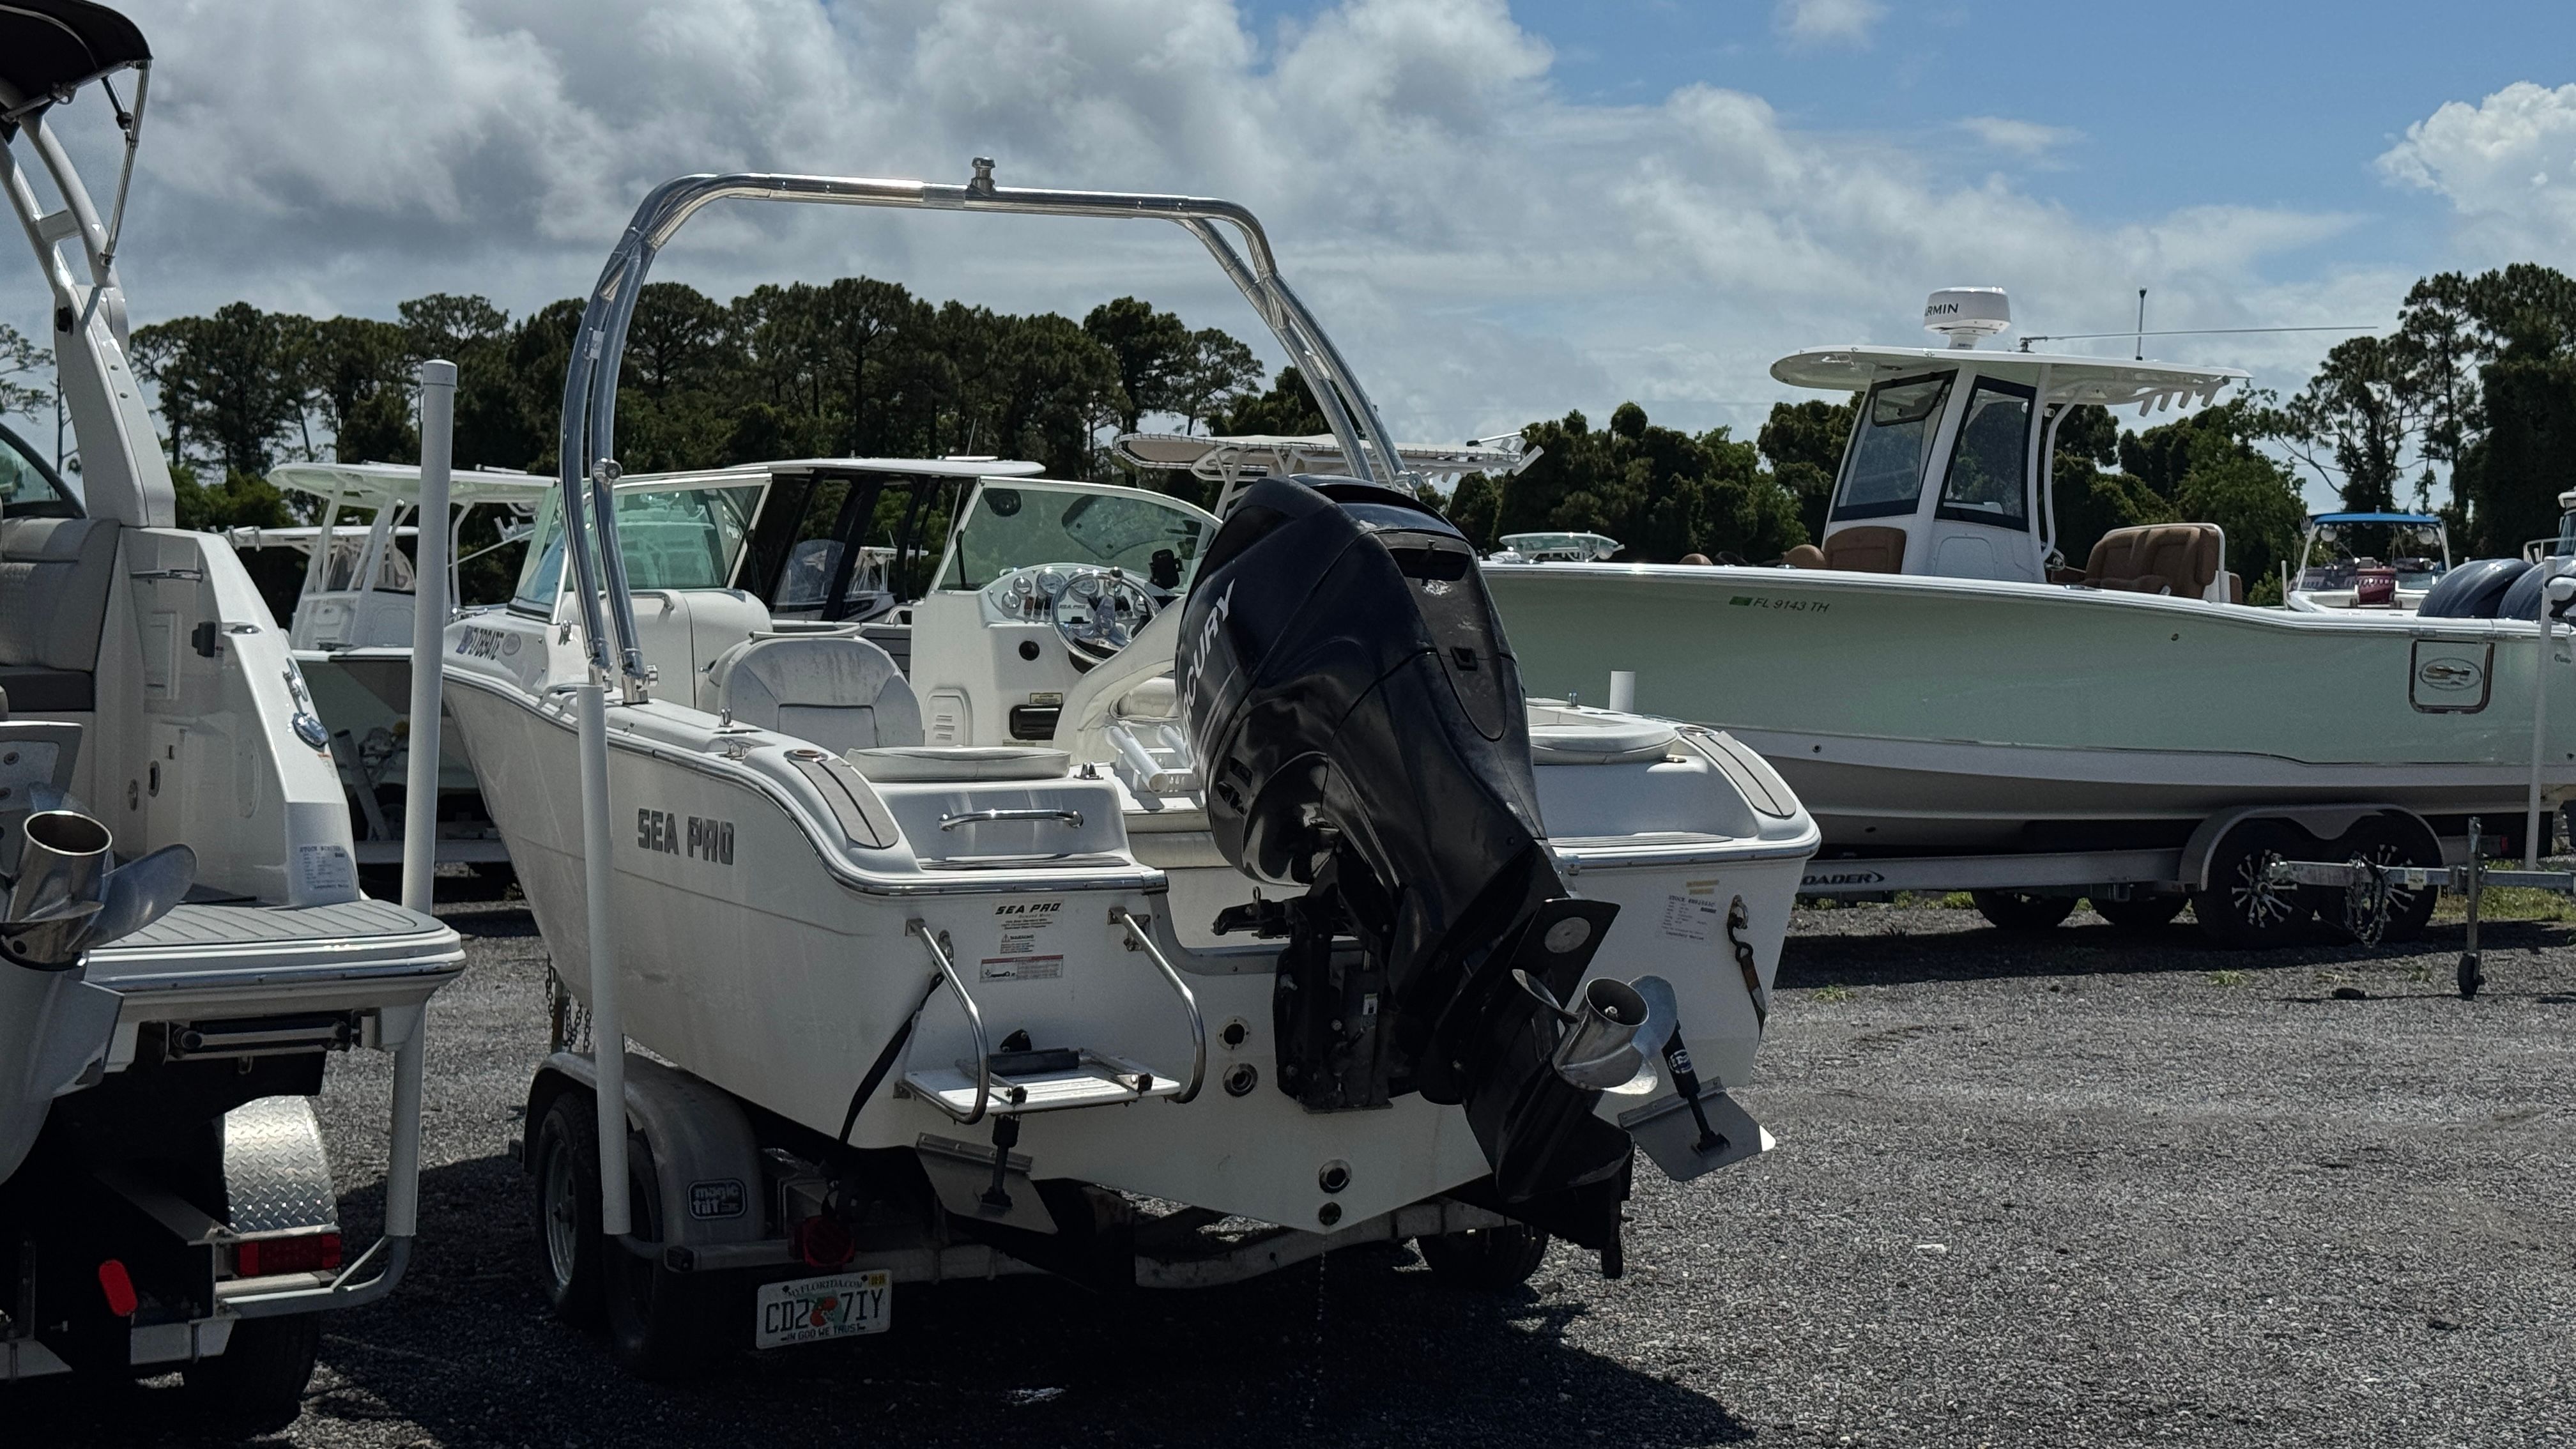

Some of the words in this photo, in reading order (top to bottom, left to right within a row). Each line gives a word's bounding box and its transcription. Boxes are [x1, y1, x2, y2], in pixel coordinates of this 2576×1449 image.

[1753, 597, 1768, 608] FL
[1773, 599, 1807, 611] 9143
[1811, 602, 1830, 613] TH
[638, 808, 679, 855] SEA
[687, 816, 734, 866] PRO
[1802, 873, 1872, 885] OADER
[995, 905, 1025, 916] SEA
[1029, 902, 1061, 913] PRO
